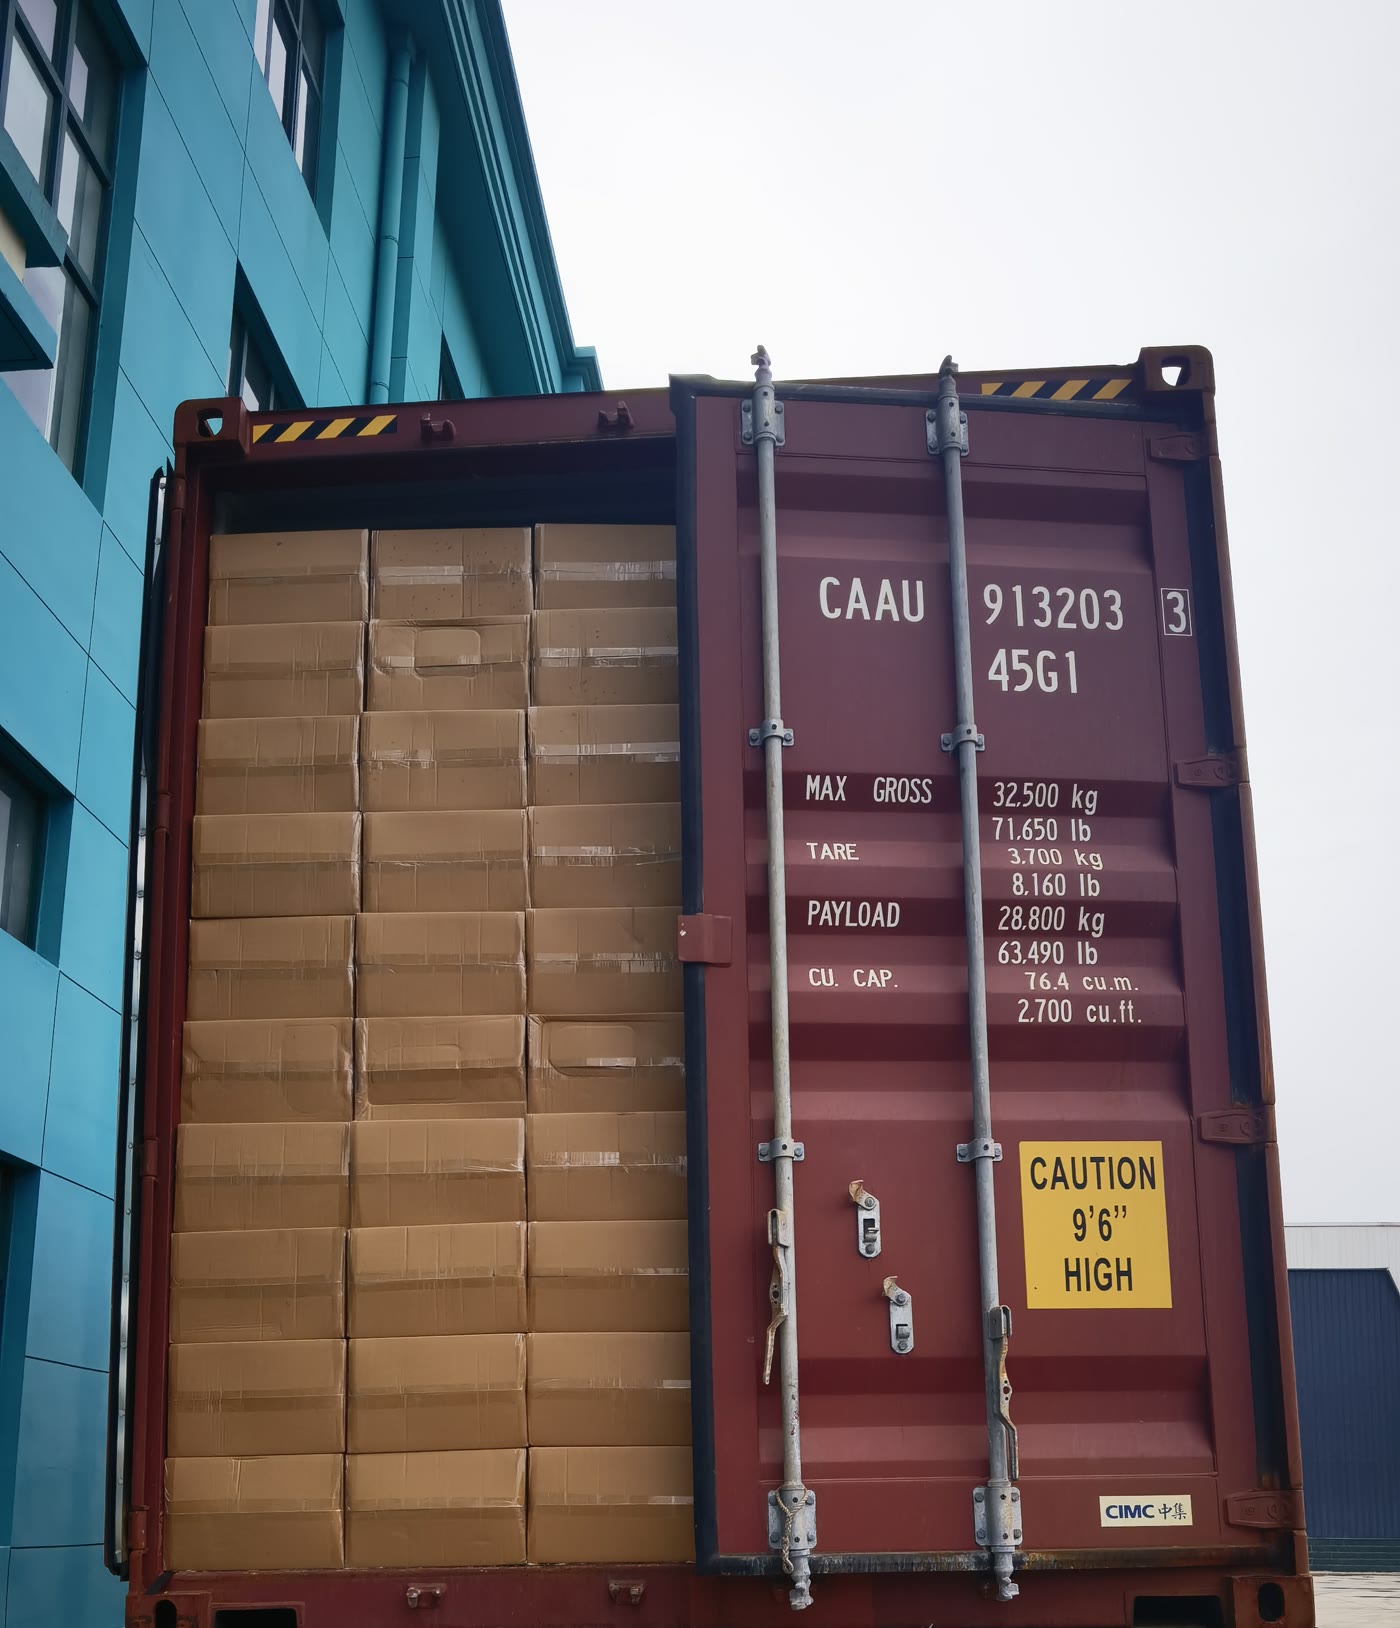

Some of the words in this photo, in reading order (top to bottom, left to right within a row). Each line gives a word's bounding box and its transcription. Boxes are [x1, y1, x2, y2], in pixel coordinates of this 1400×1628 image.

[819, 576, 924, 623] CAAU
[983, 583, 1124, 631] 913203
[1166, 591, 1187, 634] 3
[988, 648, 1078, 694] 45G1
[805, 774, 848, 802] MAX
[873, 776, 933, 804] GROSS
[1071, 783, 1099, 816] kg
[992, 816, 1058, 841] 71,650
[1070, 818, 1092, 842] lb
[806, 842, 860, 861] TARE
[1073, 848, 1104, 871] kg
[1012, 872, 1066, 897] 8,160
[1079, 873, 1101, 897] lb
[807, 900, 900, 928] PAYLOAD
[1078, 906, 1105, 938] kg
[998, 940, 1064, 965] 63,490
[1077, 941, 1098, 965] lb
[808, 968, 839, 987] CU.
[853, 968, 899, 988] CAP.
[1024, 971, 1069, 991] 76.4
[1082, 976, 1139, 991] cu.m.
[1086, 1000, 1142, 1023] cu.ft.
[1030, 1156, 1156, 1190] CAUTION
[1064, 1257, 1133, 1292] HIGH
[1105, 1504, 1155, 1519] CIMC
[1157, 1502, 1187, 1520] 中集
